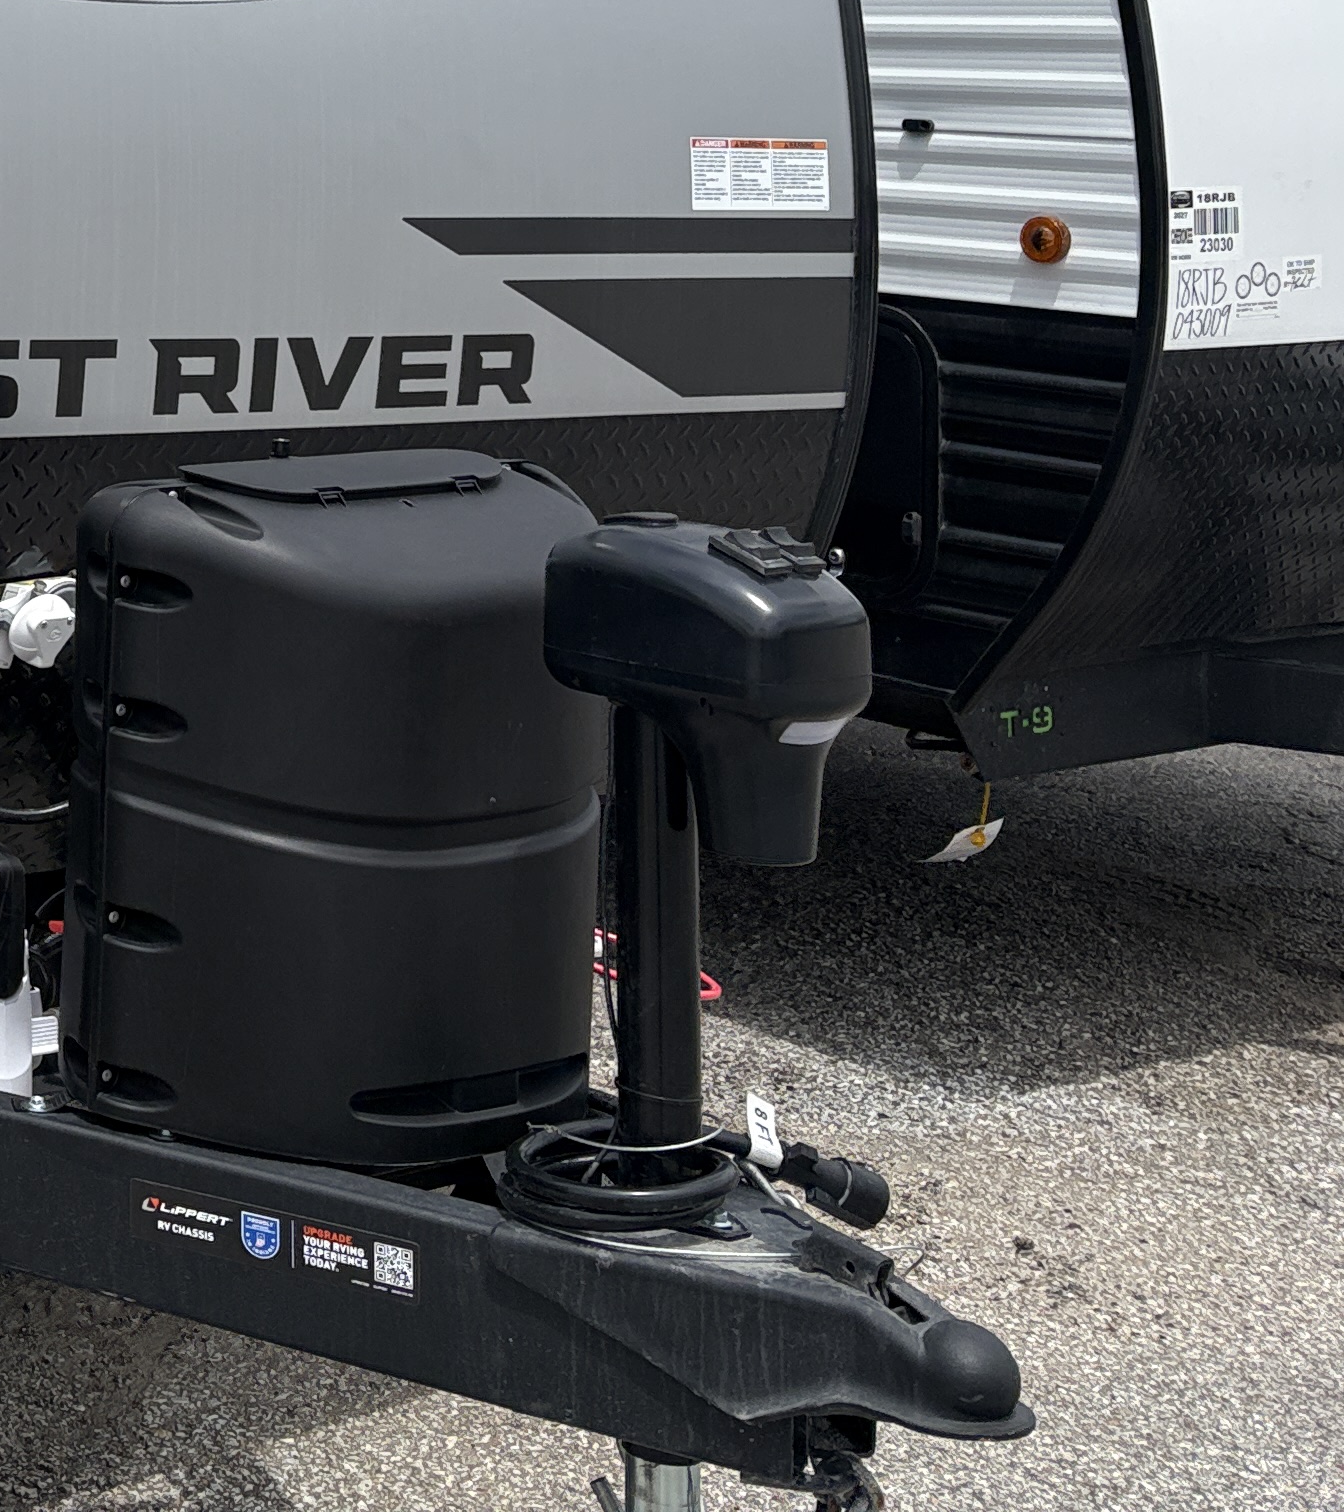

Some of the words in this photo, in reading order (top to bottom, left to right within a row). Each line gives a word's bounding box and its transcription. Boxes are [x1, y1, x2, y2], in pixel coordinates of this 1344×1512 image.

[1197, 192, 1236, 203] 18RJB
[1200, 237, 1234, 252] 23030
[148, 333, 536, 417] RIVER
[1000, 706, 1054, 738] T-9
[755, 1108, 768, 1121] 8
[755, 1122, 774, 1146] FT
[157, 1220, 171, 1231] RV
[172, 1224, 215, 1242] CHASSIS
[303, 1225, 353, 1244] UPGRADE
[303, 1235, 330, 1250] YOUR
[332, 1242, 365, 1258] RVING
[303, 1245, 369, 1269] EXPERIENCE
[303, 1255, 340, 1272] TODAY.
